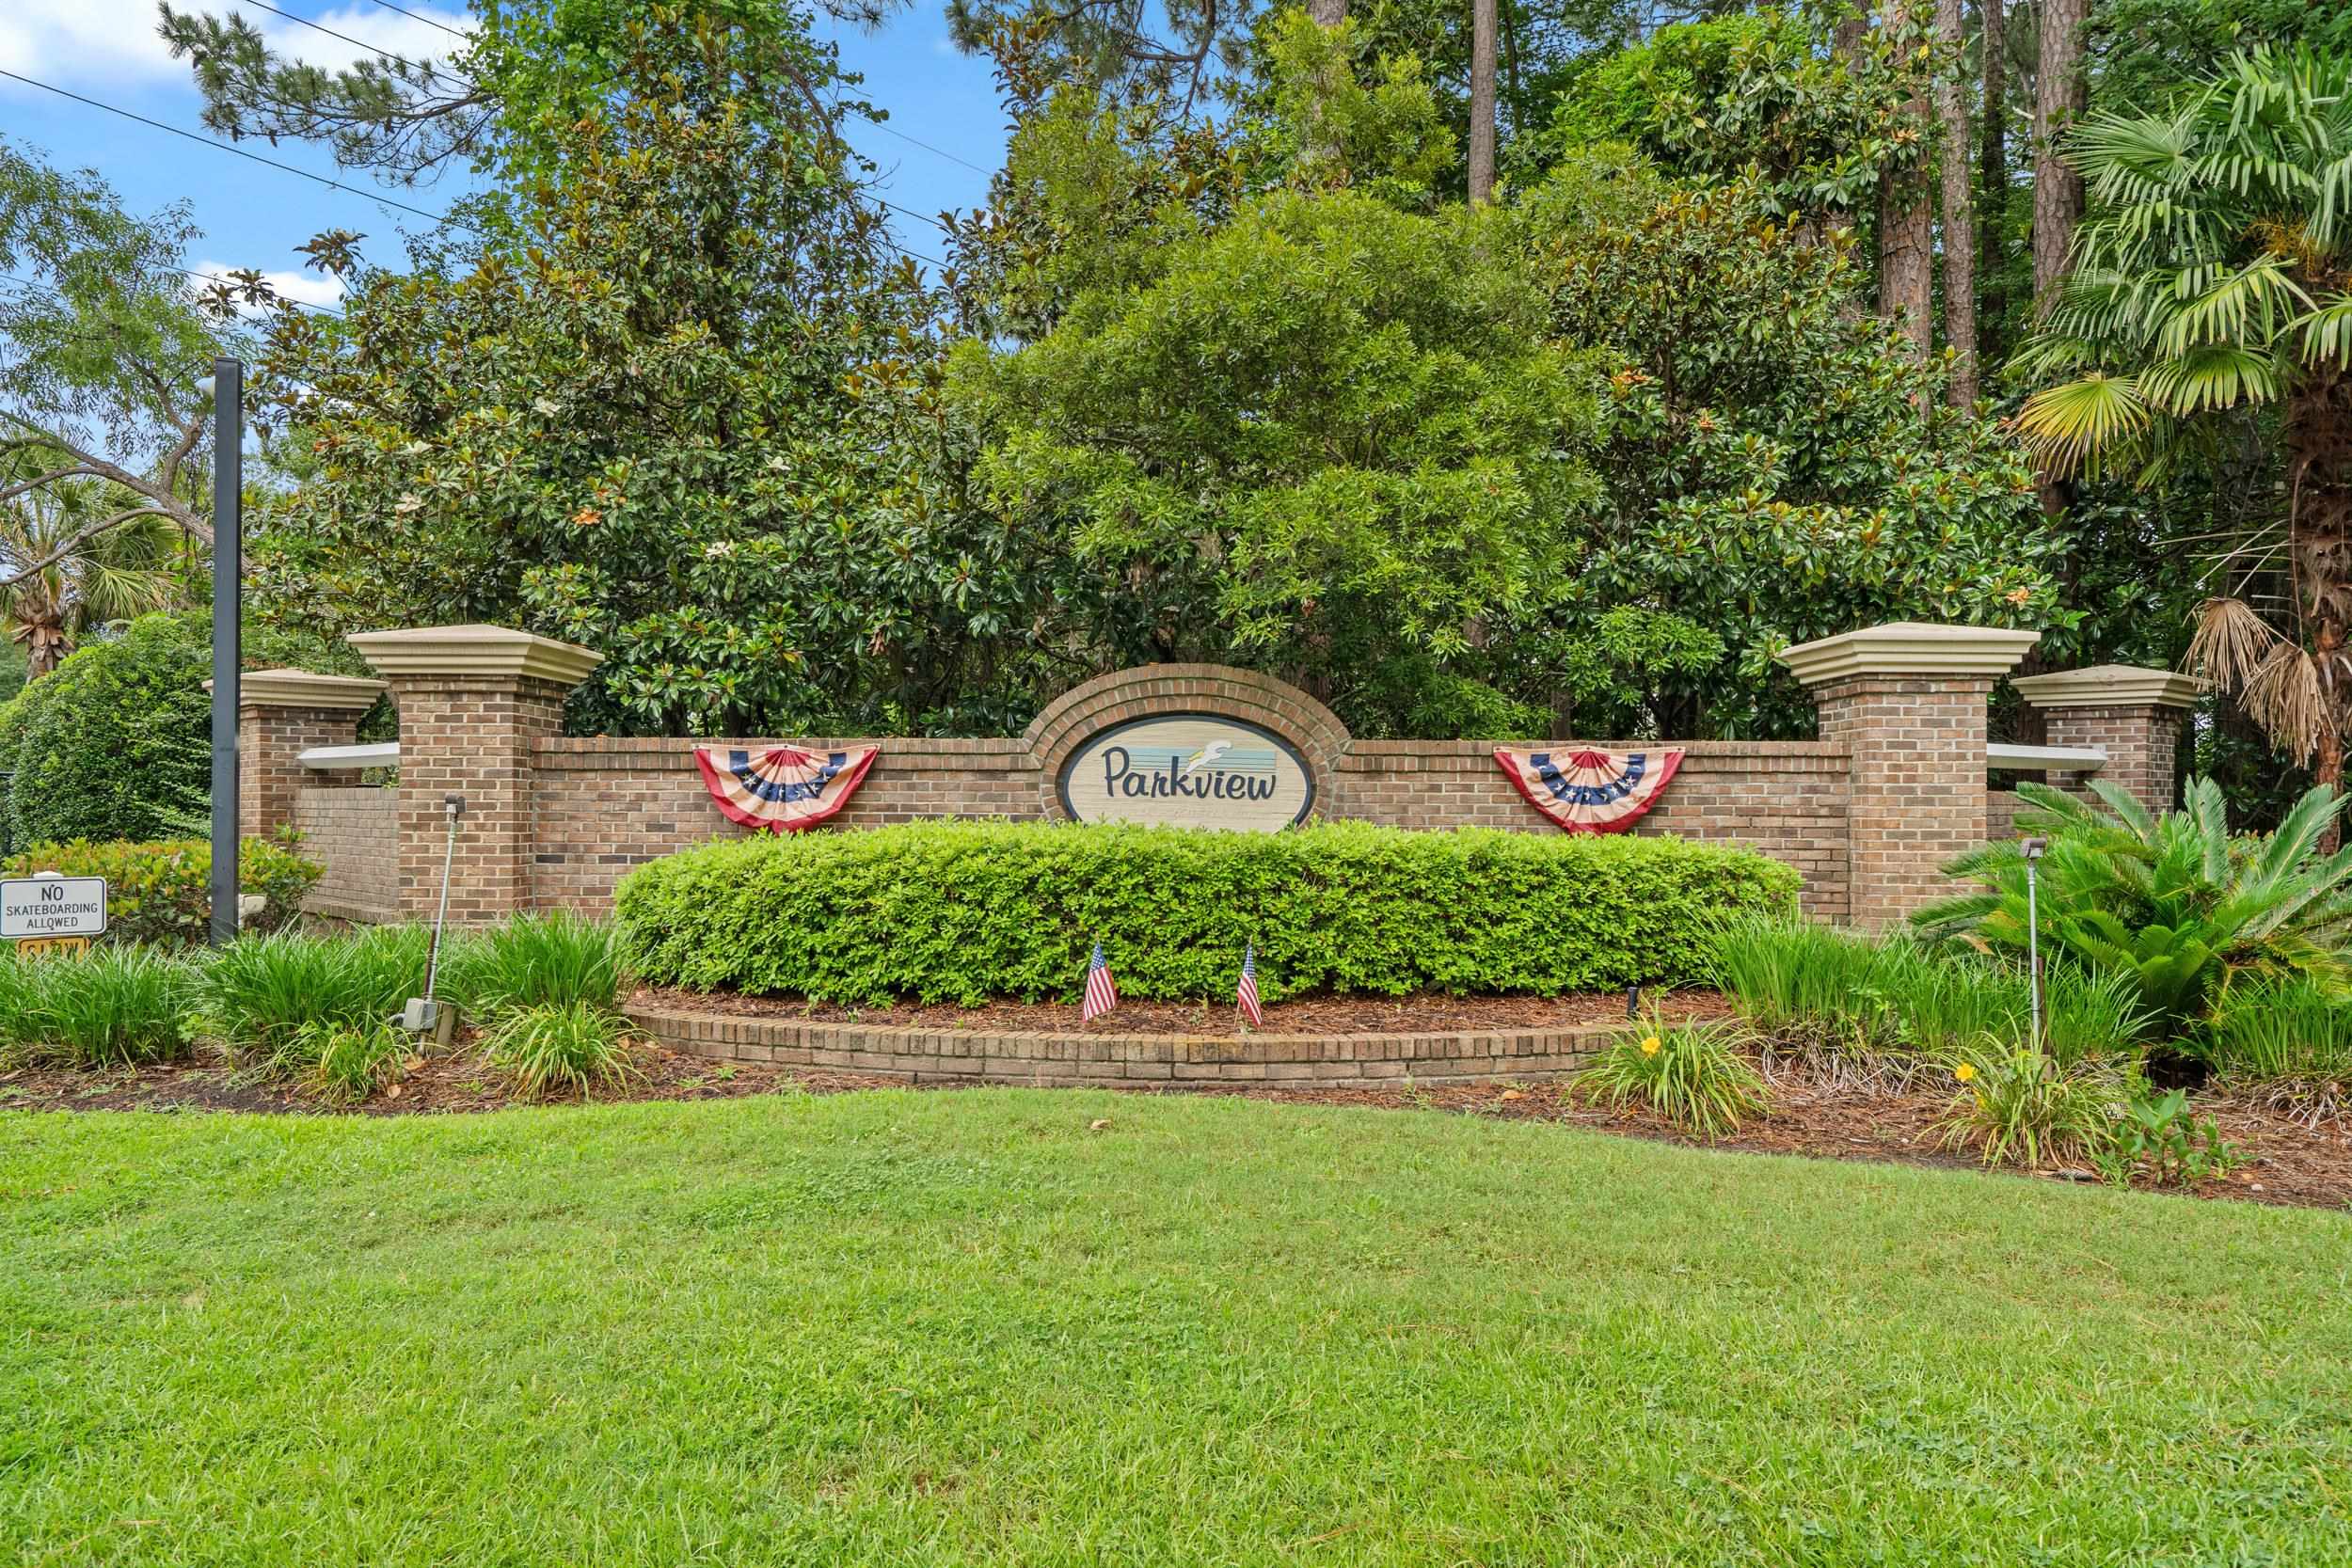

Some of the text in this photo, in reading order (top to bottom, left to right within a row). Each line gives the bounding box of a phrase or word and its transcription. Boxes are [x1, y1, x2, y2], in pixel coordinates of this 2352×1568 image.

[1102, 746, 1277, 800] Parkview
[41, 886, 64, 901] NO
[7, 903, 98, 916] SKATEBOARDING
[26, 917, 78, 928] ALLOWED
